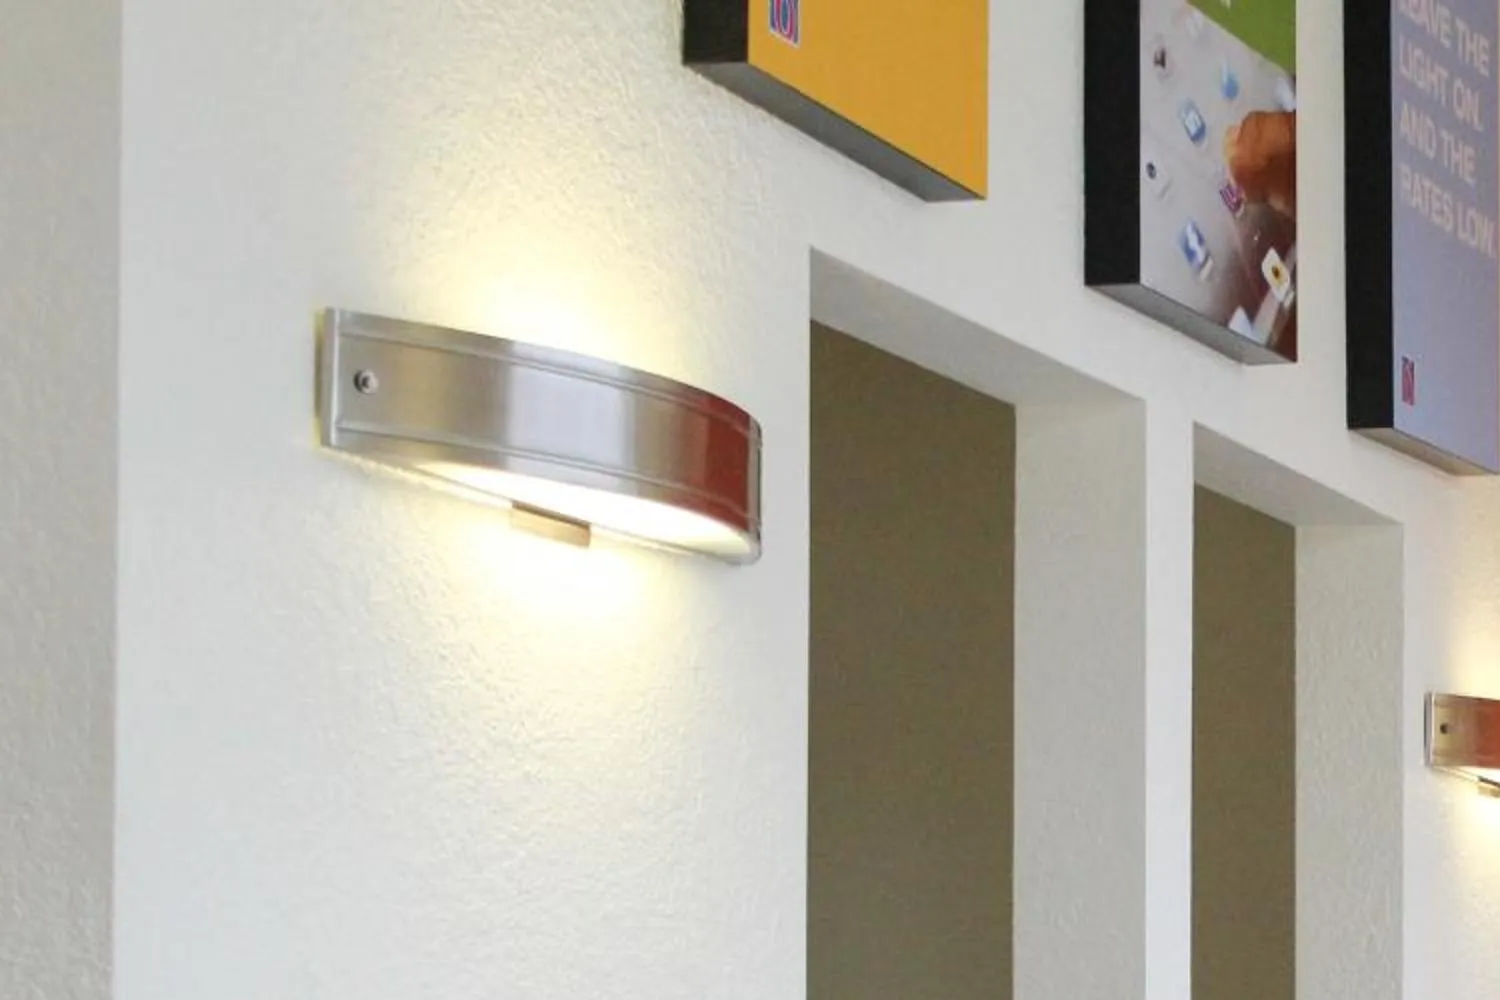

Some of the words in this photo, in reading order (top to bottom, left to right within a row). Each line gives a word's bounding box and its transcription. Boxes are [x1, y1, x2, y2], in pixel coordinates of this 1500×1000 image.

[1399, 33, 1449, 107] LIGHT
[1455, 16, 1490, 78] THE
[1400, 100, 1437, 160] AND
[1440, 129, 1477, 187] THE
[1399, 162, 1454, 233] RATES
